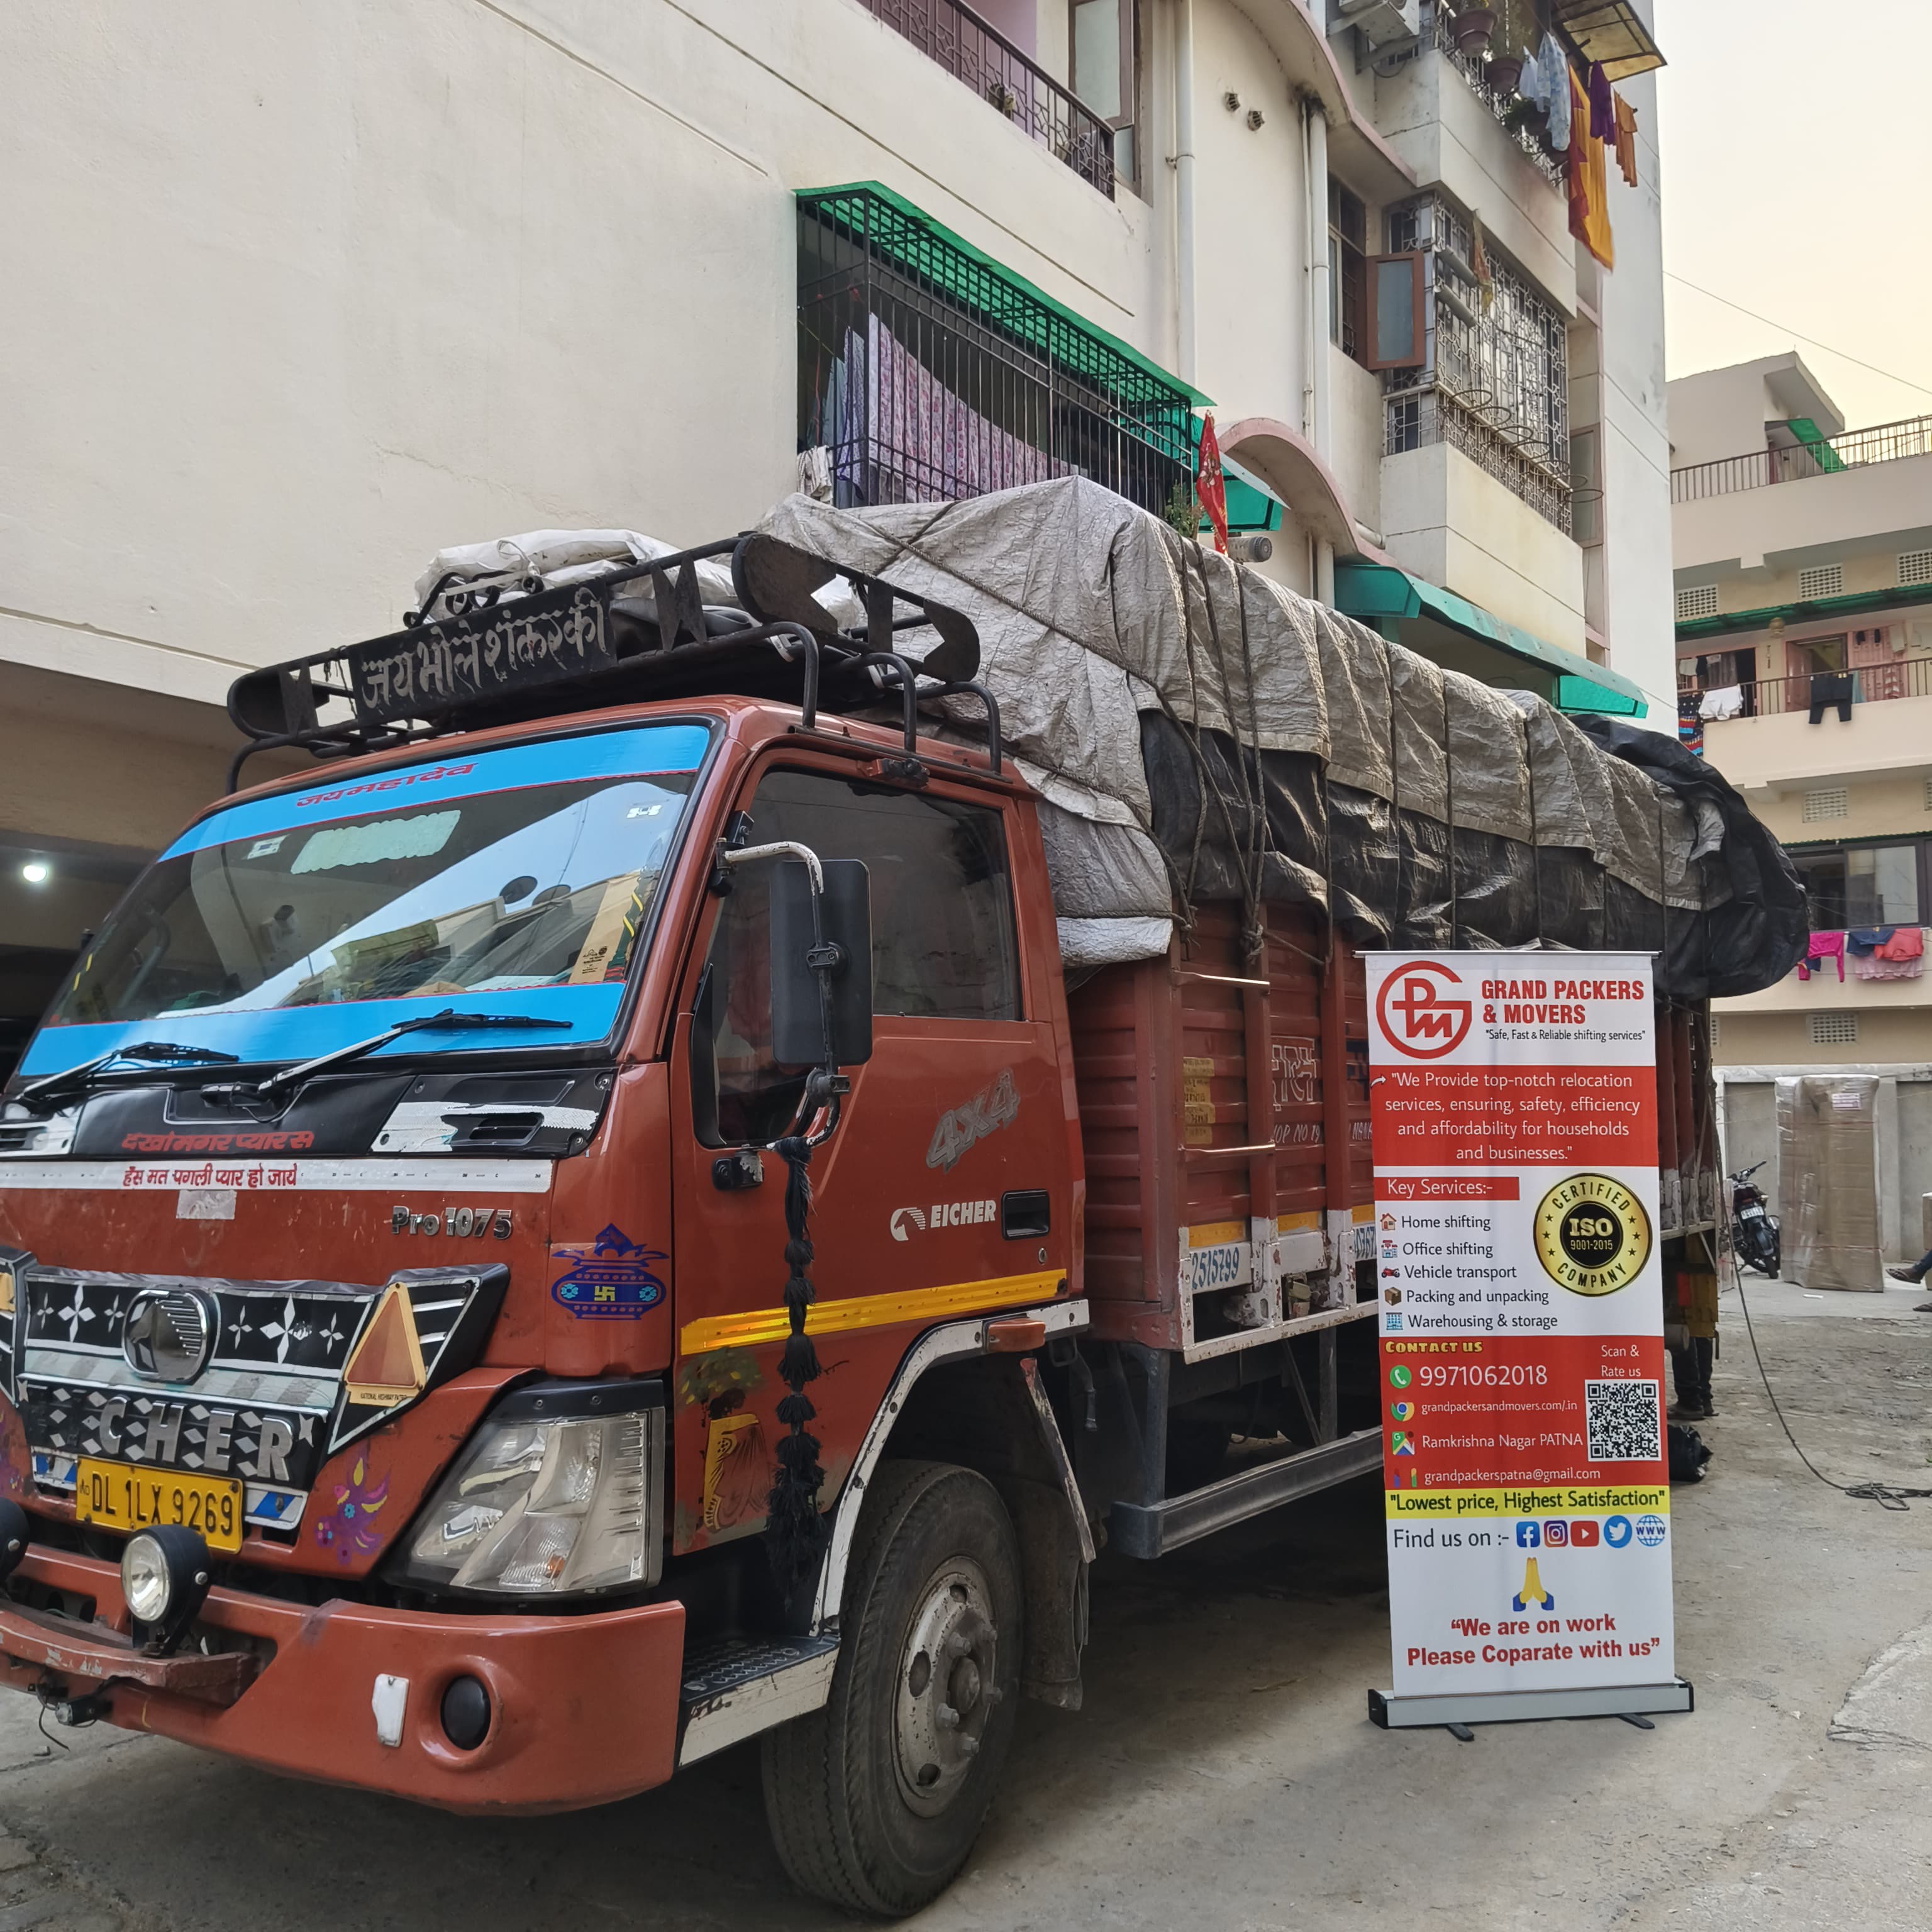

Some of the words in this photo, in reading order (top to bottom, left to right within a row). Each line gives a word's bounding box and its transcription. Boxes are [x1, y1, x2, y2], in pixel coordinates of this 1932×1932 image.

[1482, 980, 1546, 999] GRAND
[1554, 980, 1644, 999] PACKERS
[1483, 1004, 1497, 1023] &
[1504, 1004, 1585, 1024] MOVERS
[1512, 1030, 1529, 1040] Fast
[1532, 1031, 1537, 1040] &
[1540, 1030, 1571, 1040] Reliable
[1574, 1030, 1606, 1043] shifting
[1609, 1030, 1645, 1040] services"
[1391, 1072, 1419, 1087] "We
[1426, 1073, 1479, 1087] Provide
[1484, 1072, 1555, 1089] top-notch
[1560, 1072, 1632, 1087] relocation
[1385, 1098, 1445, 1113] services,
[1449, 1098, 1514, 1115] ensuring,
[1519, 1097, 1566, 1115] safety,
[1571, 1097, 1640, 1116] efficiency
[1397, 1121, 1424, 1136] and
[1430, 1121, 1517, 1139] affordability
[1522, 1121, 1542, 1136] for
[1547, 1121, 1629, 1136] households
[1456, 1146, 1484, 1160] and
[1489, 1146, 1572, 1161] businesses."
[147, 1169, 169, 1185] मत
[173, 1163, 213, 1186] पगली
[215, 1169, 244, 1186] प्यार
[1388, 1180, 1414, 1199] Key
[1420, 1179, 1493, 1194] Services:-
[1552, 1182, 1631, 1211] CERTIFIED
[930, 1199, 996, 1228] EICHER
[391, 1206, 440, 1237] Pro
[445, 1207, 512, 1240] 1075
[1401, 1216, 1440, 1229] Home
[1445, 1215, 1491, 1231] shifting
[1569, 1218, 1613, 1236] ISO
[1403, 1242, 1442, 1256] Office
[1446, 1241, 1493, 1258] shifting
[1570, 1240, 1613, 1250] 9001-2015
[1404, 1265, 1452, 1279] Vehicle
[1456, 1266, 1517, 1282] transport
[1557, 1262, 1626, 1287] COMPANY
[1407, 1290, 1455, 1306] Packing
[1458, 1289, 1482, 1302] and
[1487, 1289, 1549, 1305] unpacking
[1408, 1314, 1493, 1331] Warehousing
[1498, 1314, 1507, 1326] &
[1512, 1315, 1558, 1330] storage
[1601, 1345, 1626, 1358] Scan
[1630, 1346, 1640, 1357] &
[1419, 1365, 1548, 1386] 9971062018
[1601, 1365, 1624, 1377] Rate
[1629, 1368, 1641, 1377] us
[1422, 1435, 1494, 1448] Ramkrishna
[1499, 1434, 1536, 1450] Nagar
[1540, 1433, 1583, 1446] PATNA
[1424, 1467, 1601, 1485] grandpackerspatna@gmail.com
[92, 1470, 116, 1516] DL
[125, 1478, 162, 1524] 1LX
[172, 1486, 233, 1536] 9269
[1391, 1494, 1452, 1511] "Lowest
[1457, 1492, 1499, 1514] price,
[1504, 1491, 1563, 1513] Highest
[1567, 1490, 1665, 1507] Satisfaction"
[1394, 1528, 1434, 1548] Find
[1441, 1533, 1462, 1547] us
[1467, 1532, 1491, 1546] on
[1497, 1620, 1530, 1635] are
[1536, 1619, 1559, 1633] on
[1566, 1614, 1616, 1633] work
[1407, 1646, 1475, 1666] Please
[1482, 1641, 1573, 1666] Coparate
[1579, 1640, 1623, 1658] with
